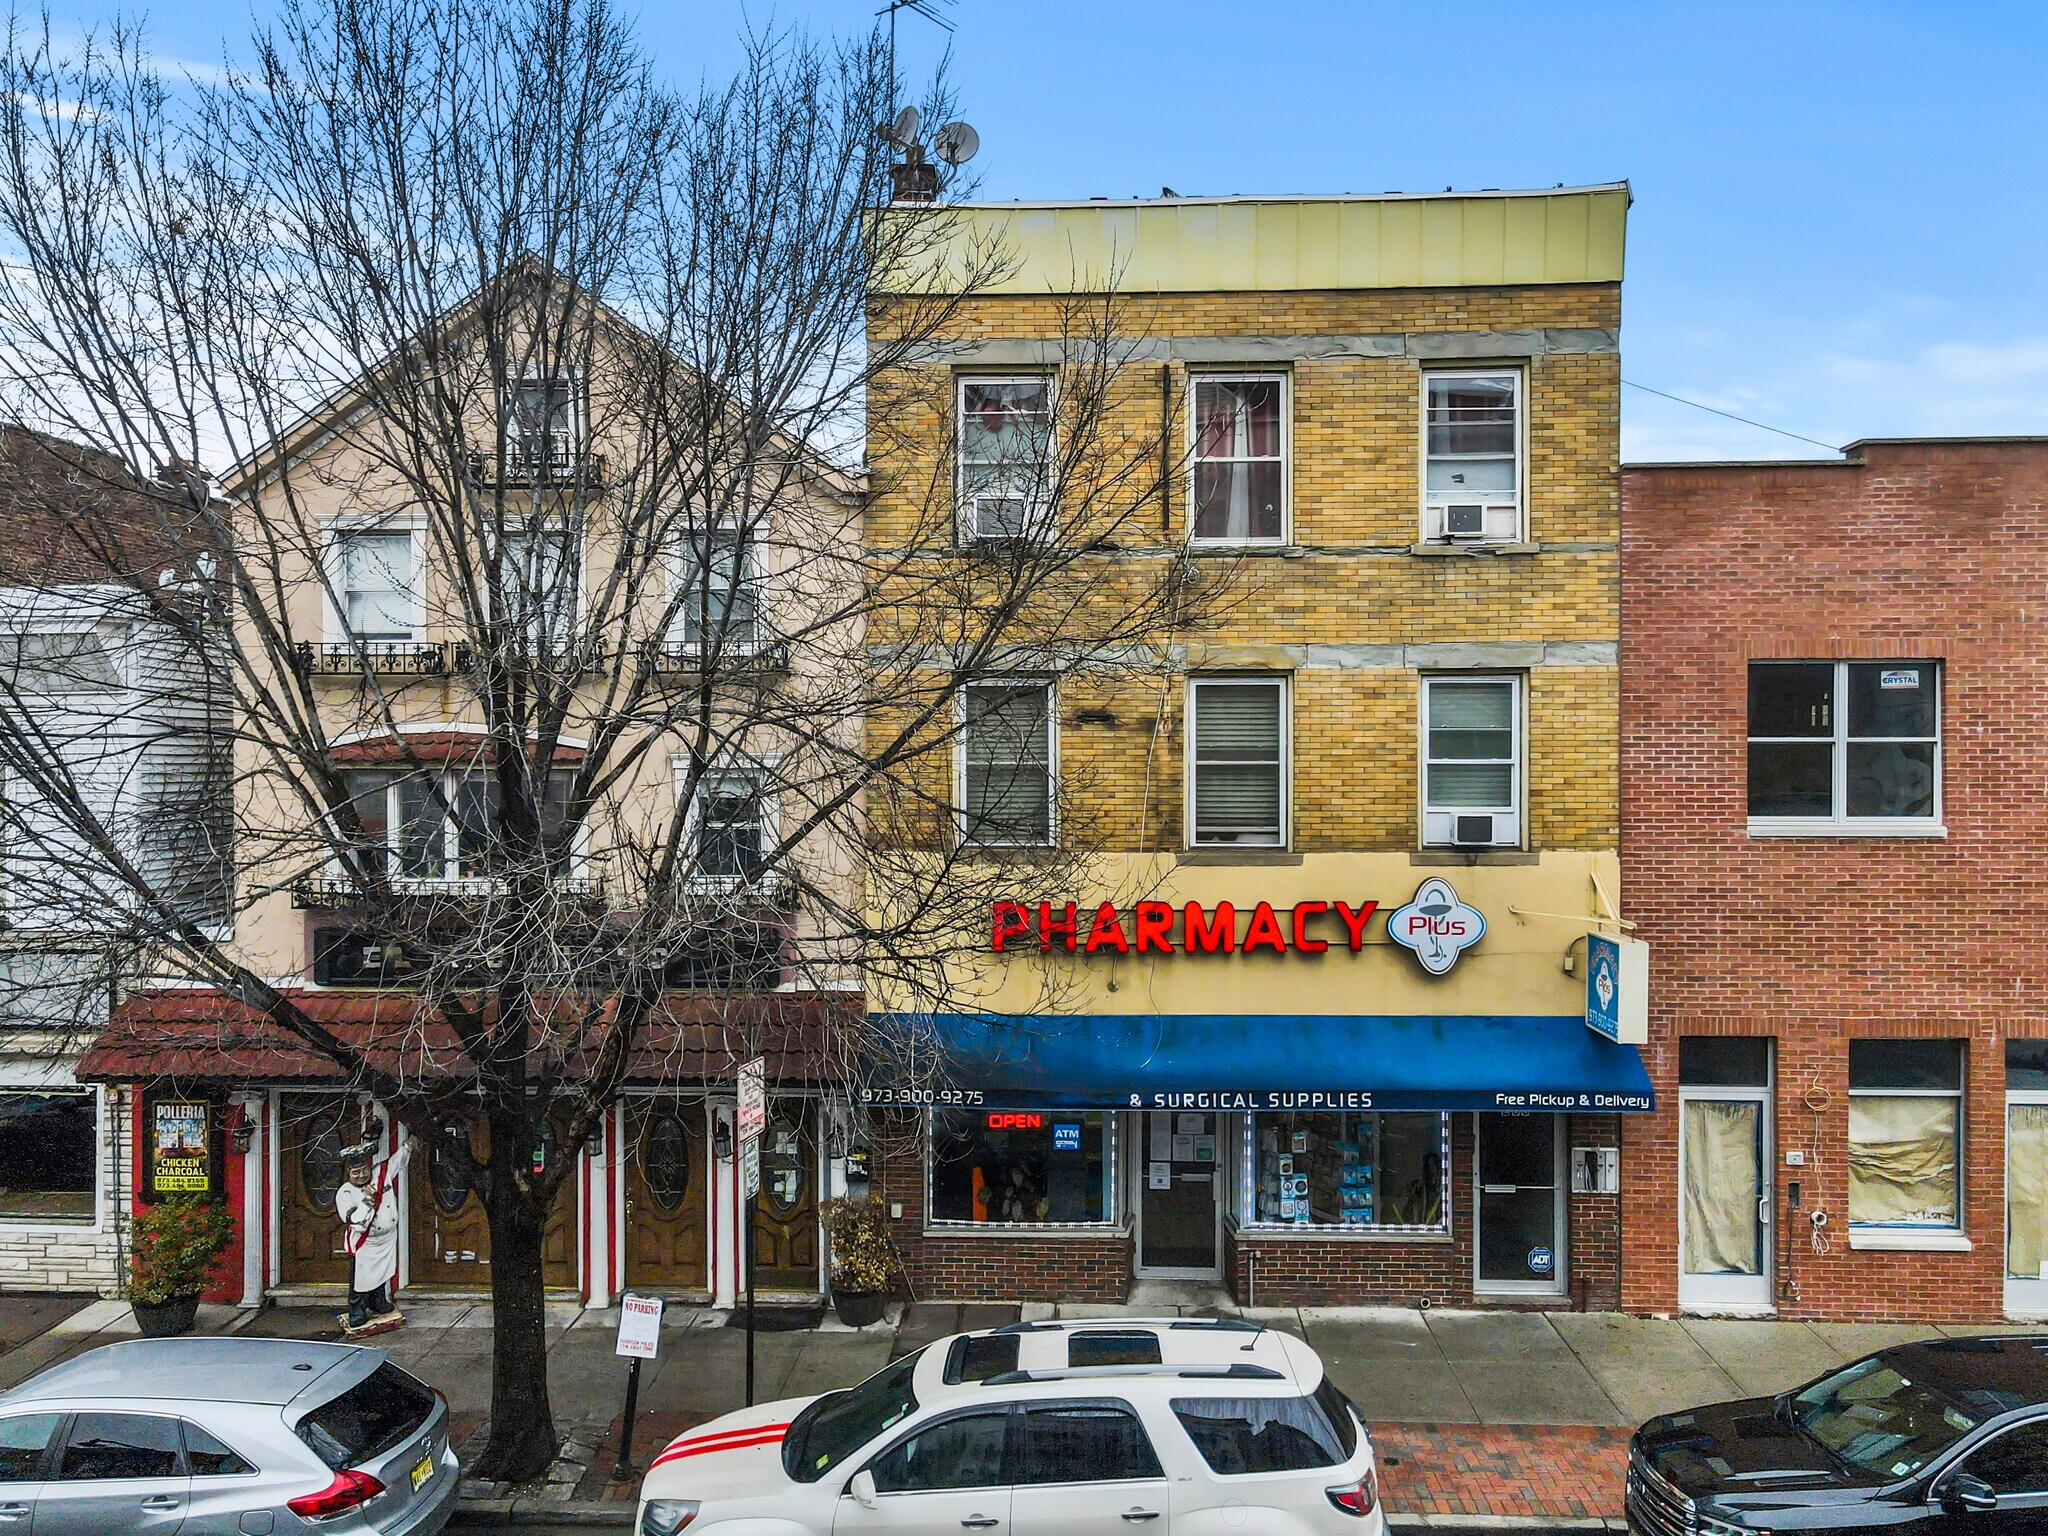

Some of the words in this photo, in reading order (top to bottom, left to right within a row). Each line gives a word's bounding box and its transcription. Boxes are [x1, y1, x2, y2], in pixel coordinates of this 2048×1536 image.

[1882, 676, 1917, 684] CRYSTAL
[992, 900, 1379, 953] PHARMACY
[1408, 916, 1466, 936] Plus
[861, 1089, 984, 1105] 973-900-9275
[1129, 1093, 1142, 1108] &
[1154, 1092, 1259, 1108] SURGICAL
[1268, 1092, 1372, 1108] SUPPLIES
[1495, 1093, 1526, 1106] Free
[1529, 1093, 1575, 1108] Pickup
[1579, 1094, 1590, 1106] &
[1594, 1094, 1650, 1109] Delivery
[156, 1104, 205, 1119] POLLERIA
[988, 1113, 1042, 1129] OPEN
[1055, 1129, 1079, 1138] ATM
[161, 1158, 200, 1167] CHICKEN
[156, 1167, 205, 1176] CHARCOAL
[1532, 1255, 1550, 1265] ADT
[625, 1301, 633, 1312] NO
[633, 1303, 659, 1315] PARKING
